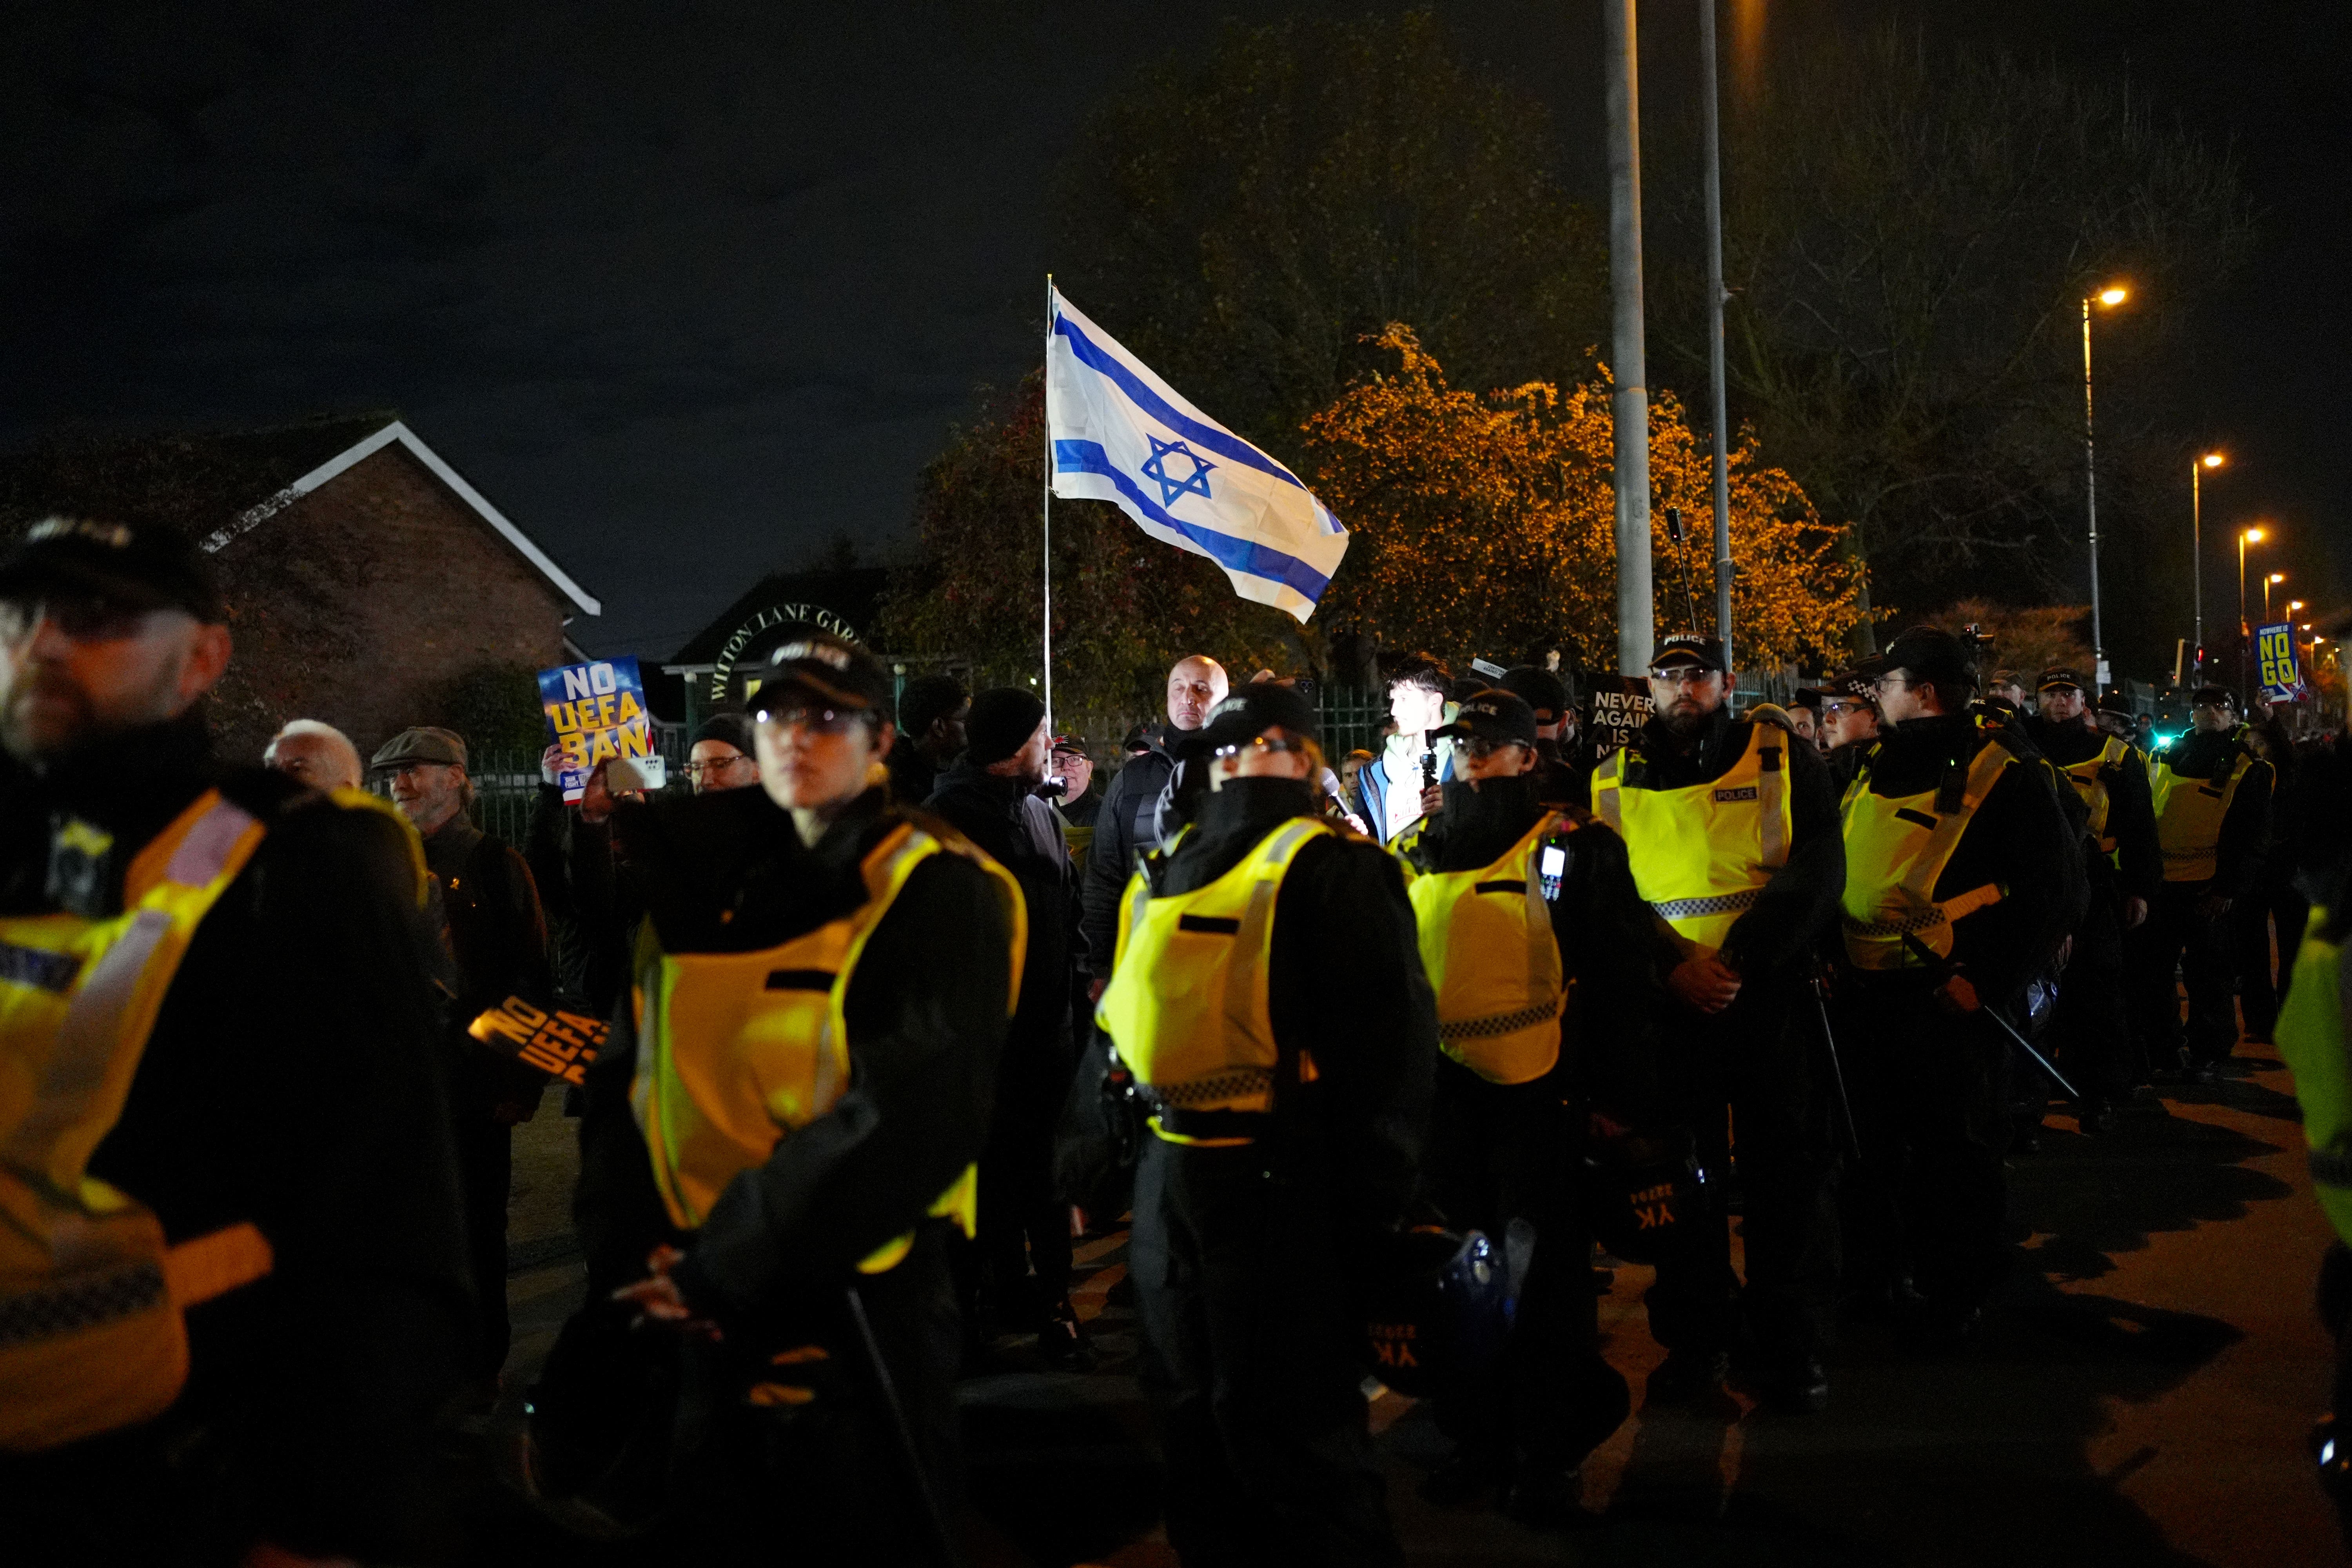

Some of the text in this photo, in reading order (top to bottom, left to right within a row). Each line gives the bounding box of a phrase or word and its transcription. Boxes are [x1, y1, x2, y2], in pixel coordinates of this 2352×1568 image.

[1664, 634, 1706, 646] POLICE
[2259, 626, 2282, 635] NOWHERE
[711, 623, 753, 700] WITTON
[757, 603, 811, 628] LANE
[817, 610, 860, 646] GAR
[2259, 632, 2290, 661] NO
[563, 662, 617, 701] NO
[2261, 658, 2296, 686] GO
[551, 691, 643, 733] UEFA
[1595, 691, 1655, 713] NEVER
[559, 722, 648, 769] BAN
[1612, 728, 1629, 744] IS
[1718, 789, 1754, 800] POLICE
[518, 1009, 602, 1075] UEFA
